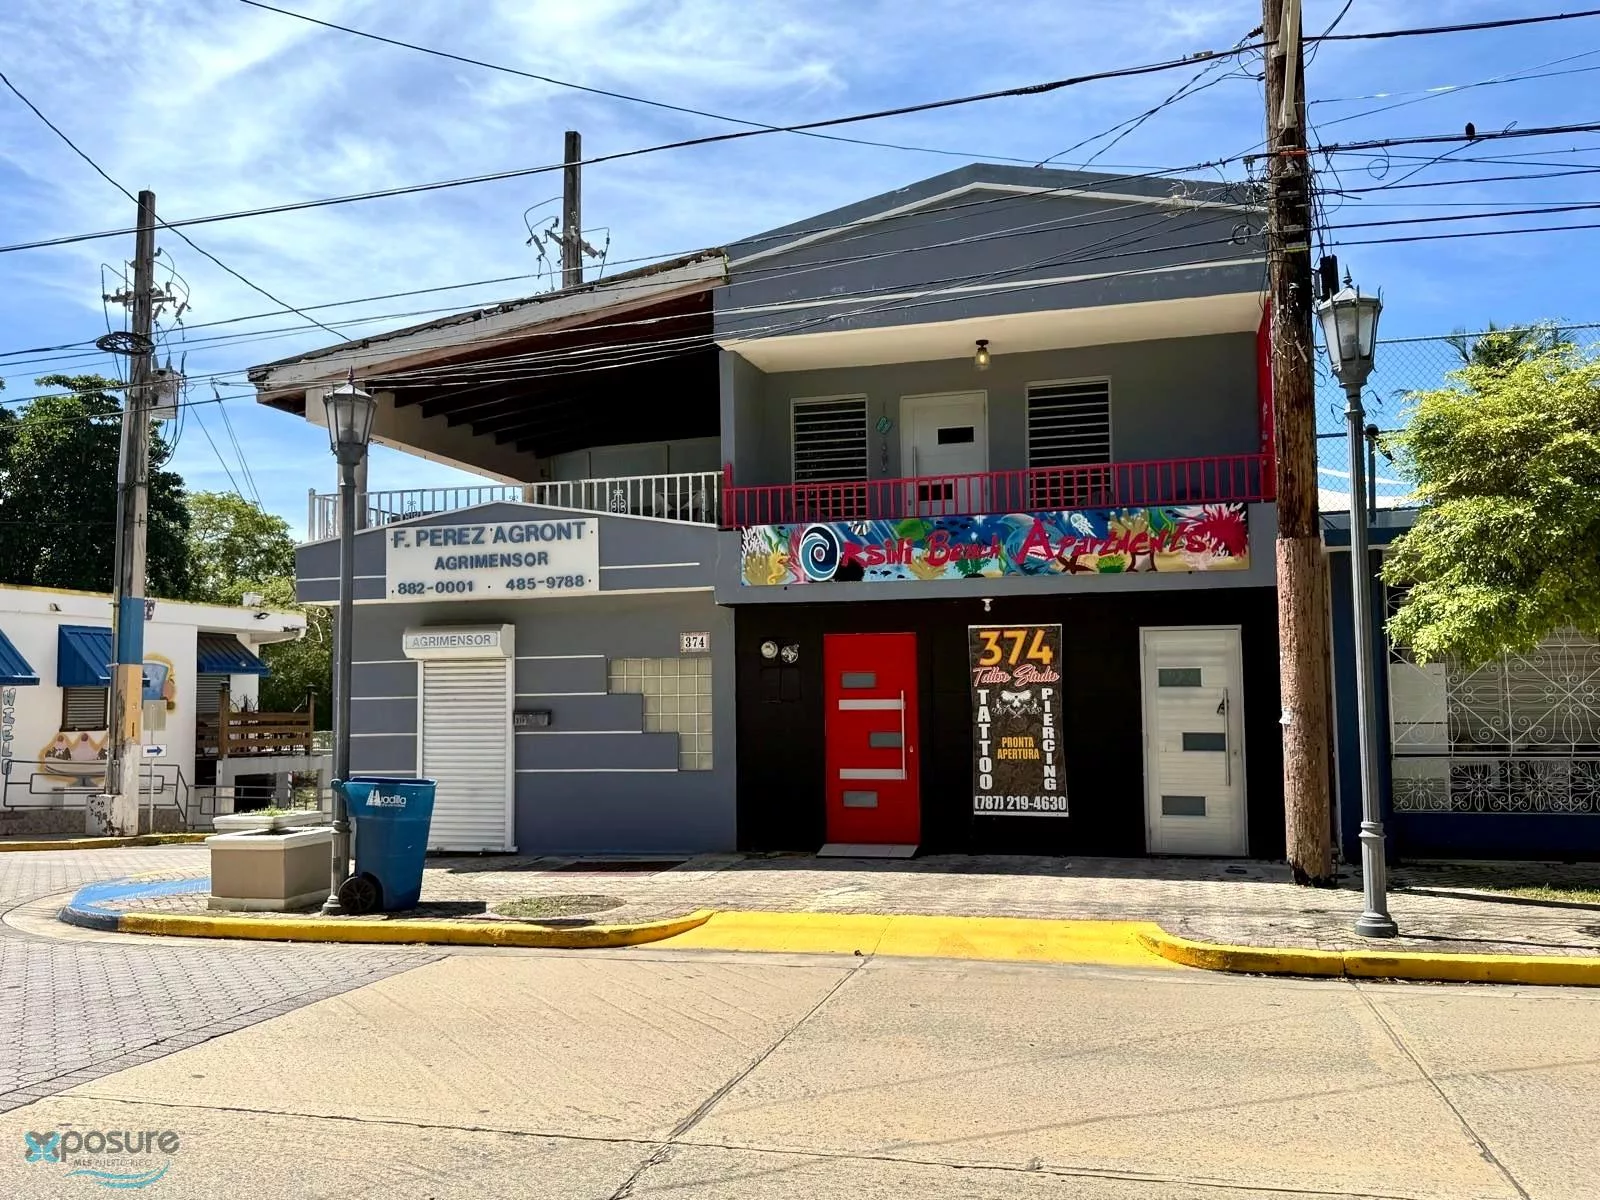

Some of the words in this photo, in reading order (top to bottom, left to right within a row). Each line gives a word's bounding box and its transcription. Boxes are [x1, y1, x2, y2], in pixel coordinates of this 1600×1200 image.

[392, 530, 411, 548] F.
[415, 526, 485, 548] PEREZ
[492, 520, 587, 545] AGRONT
[434, 551, 549, 571] AGRIMENSOR
[397, 580, 474, 595] 882-0001
[505, 574, 585, 591] 485-9788
[411, 633, 492, 648] AGRIMENSOR
[684, 636, 705, 649] 374
[979, 629, 1054, 667] 374
[977, 689, 993, 790] TATTOO
[1001, 736, 1035, 748] PRONTA
[1041, 687, 1057, 791] PIERCING
[997, 748, 1041, 760] APERTURA
[974, 795, 1005, 810] (787)
[1006, 795, 1067, 811] 219-4630
